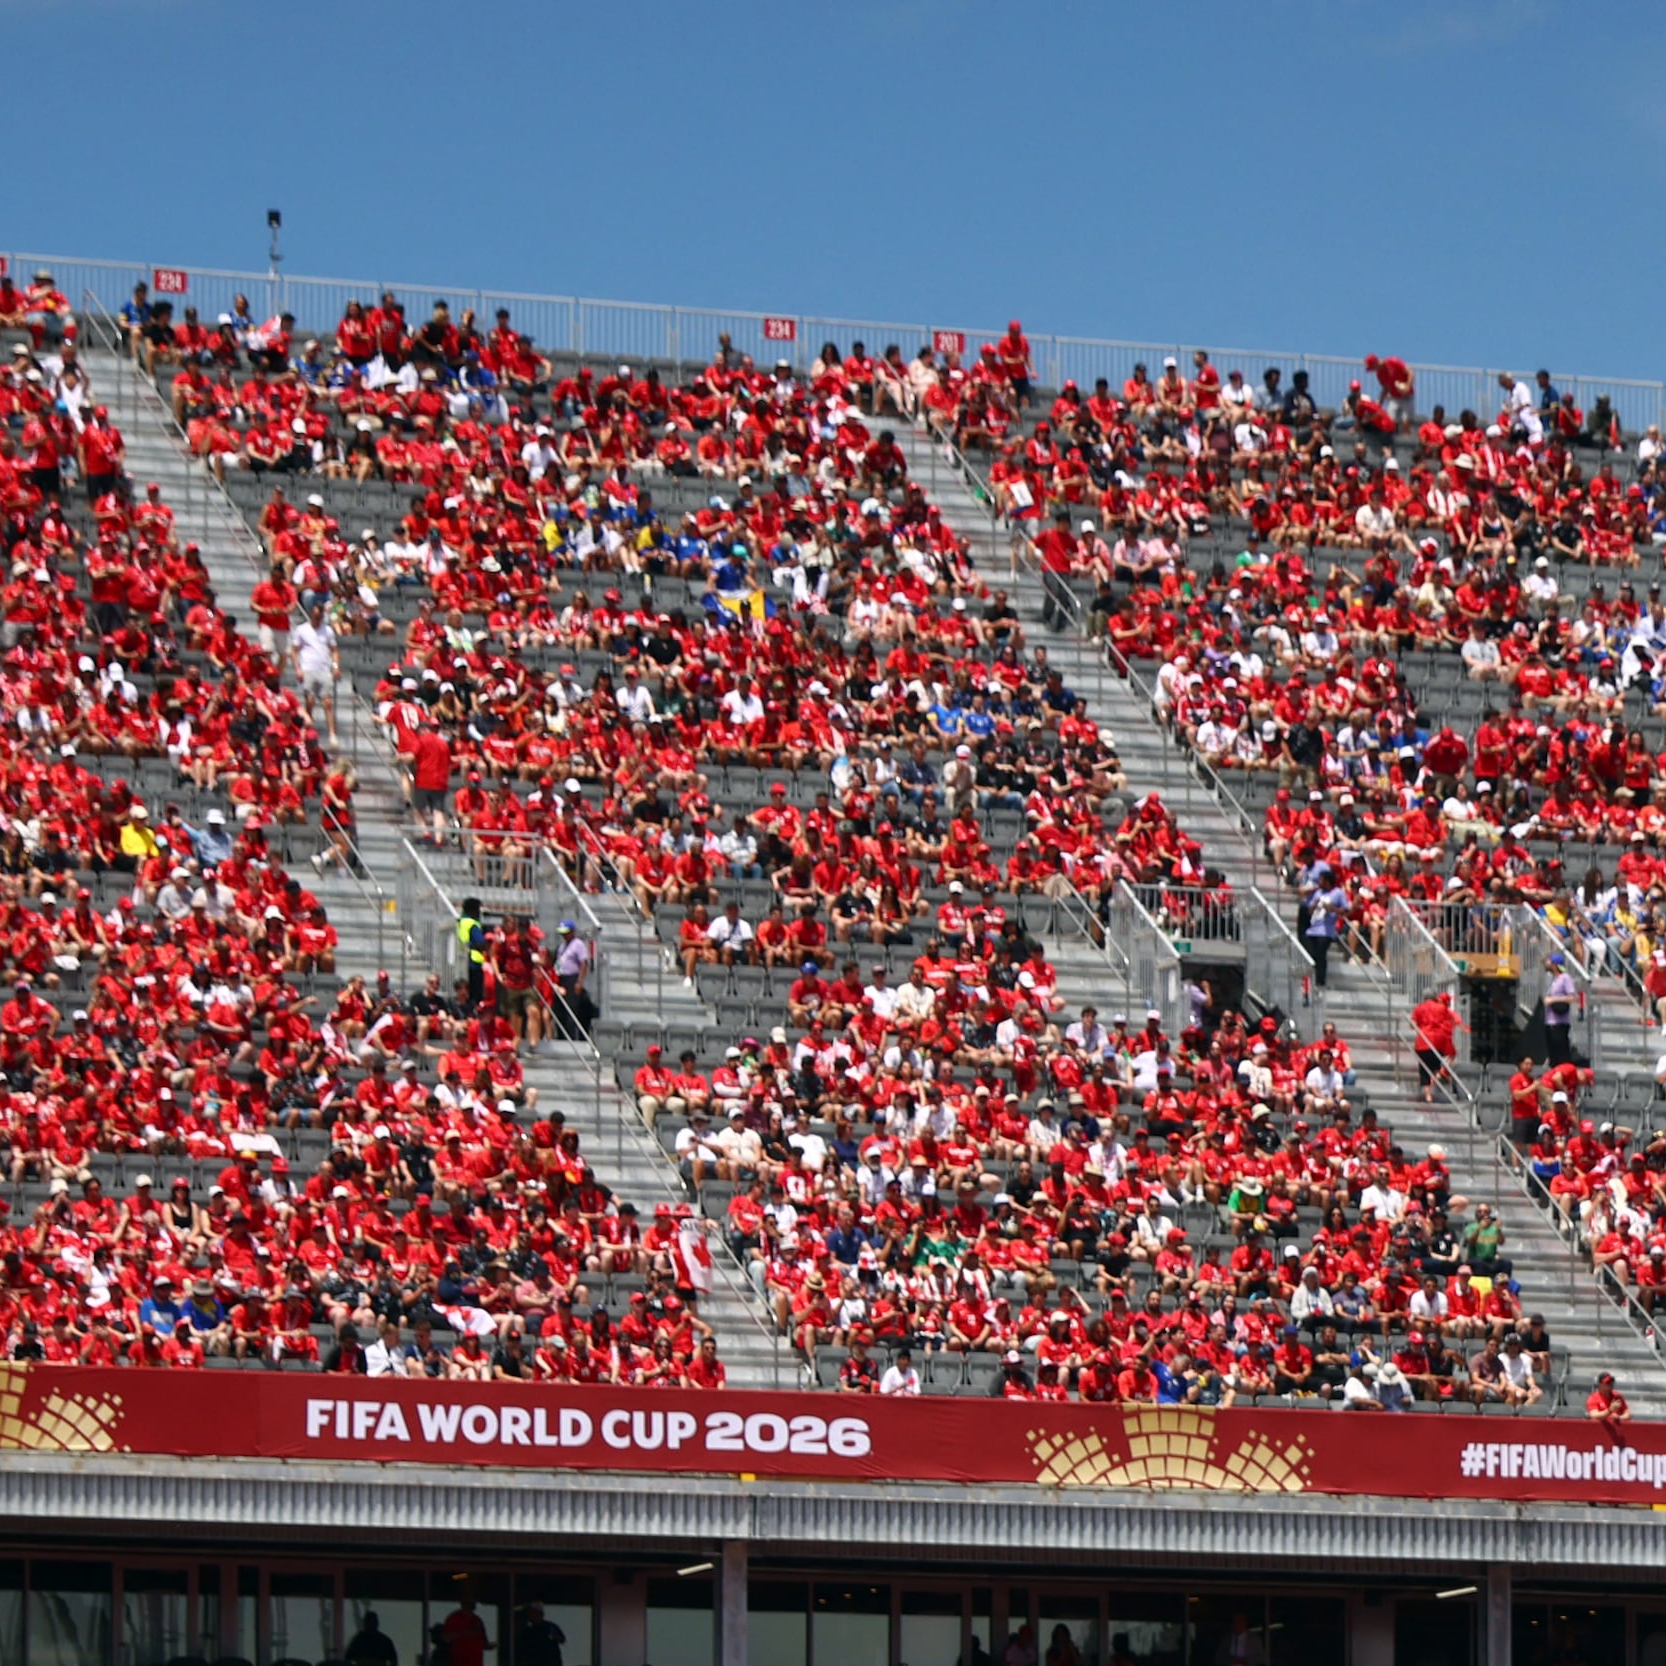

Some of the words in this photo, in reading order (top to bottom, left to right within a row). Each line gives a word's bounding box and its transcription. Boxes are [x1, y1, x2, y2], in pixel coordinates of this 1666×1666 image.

[769, 320, 791, 339] 234
[939, 333, 959, 352] 201
[307, 1400, 410, 1441] FIFA
[418, 1404, 592, 1447] WORLD
[602, 1410, 696, 1450] CUP
[706, 1412, 871, 1457] 2026
